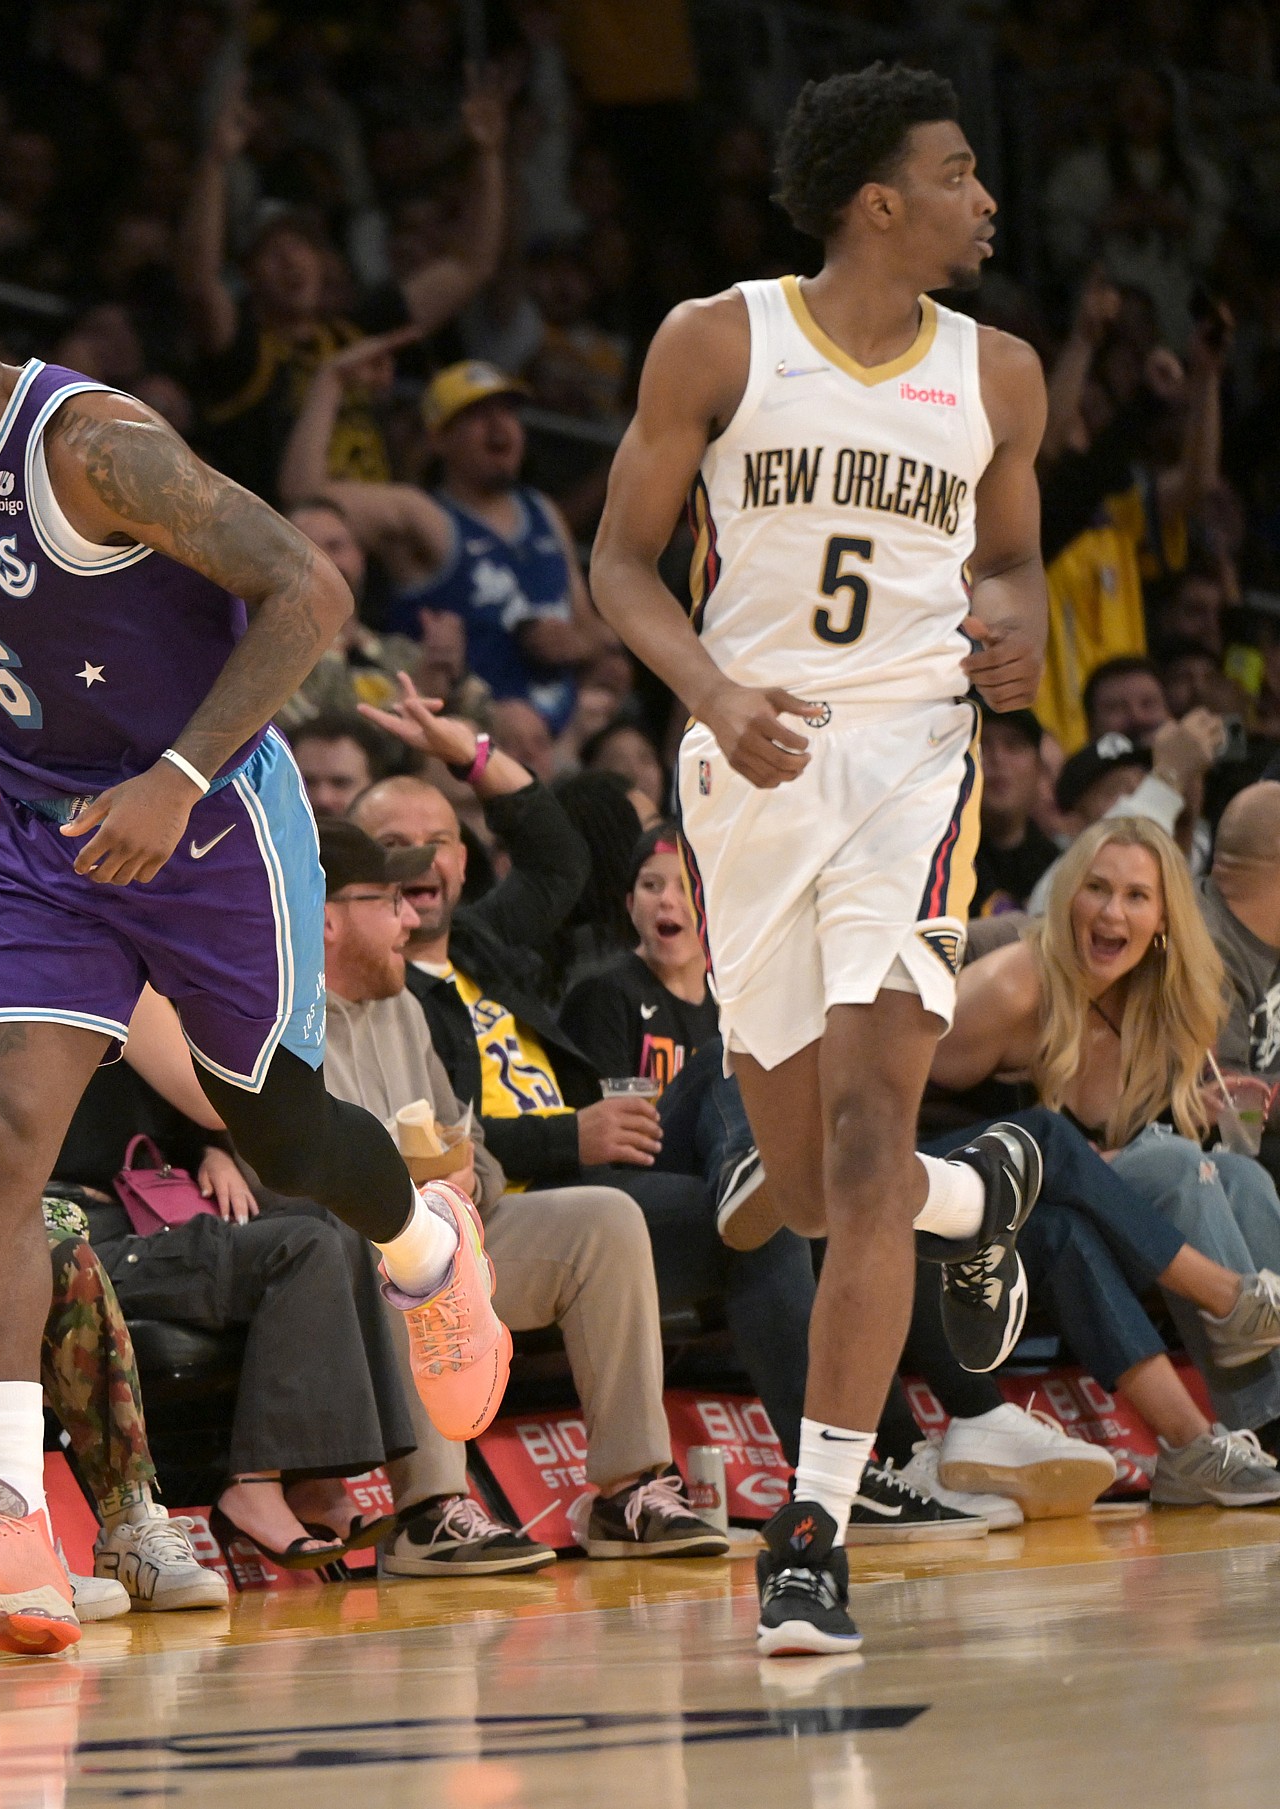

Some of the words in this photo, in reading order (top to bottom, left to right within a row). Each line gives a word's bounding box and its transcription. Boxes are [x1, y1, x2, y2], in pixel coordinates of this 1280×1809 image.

[900, 383, 957, 406] ibotta
[741, 446, 824, 510] NEW
[833, 447, 967, 536] ORLEANS
[812, 534, 874, 646] 5
[517, 1420, 588, 1465] BIO
[696, 1402, 780, 1444] BIO
[541, 1465, 587, 1488] STE
